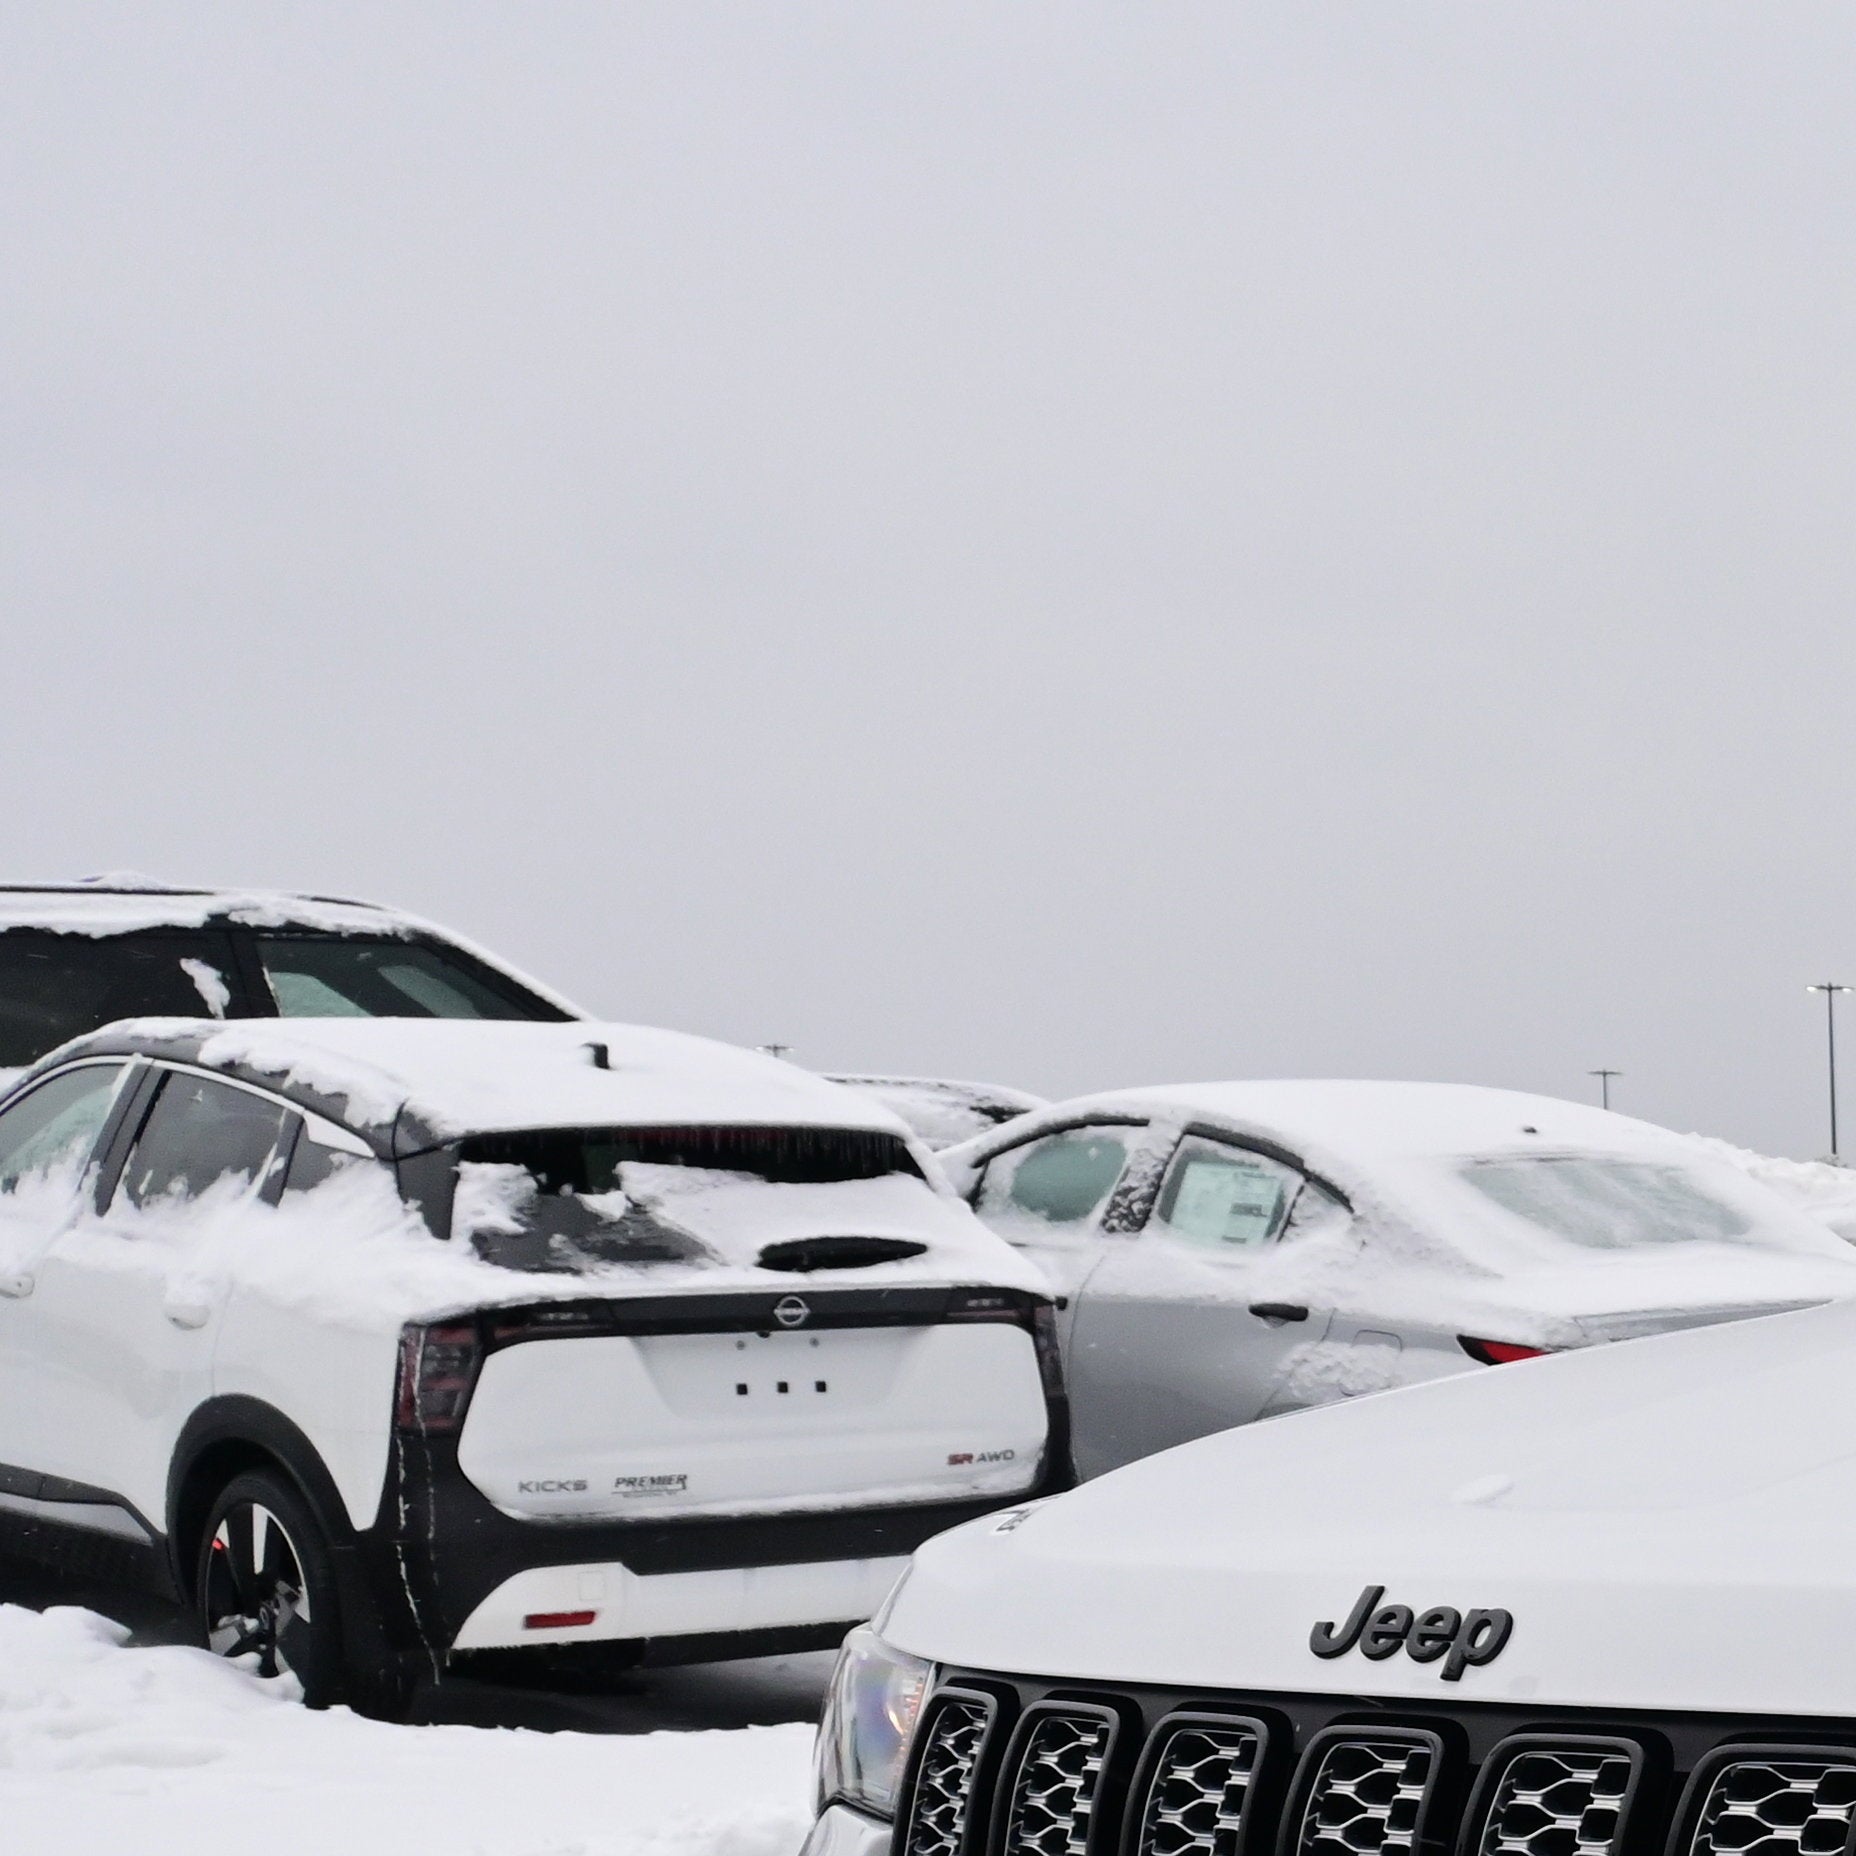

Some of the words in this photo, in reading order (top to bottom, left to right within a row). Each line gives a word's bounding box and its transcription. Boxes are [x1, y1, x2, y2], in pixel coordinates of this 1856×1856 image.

[947, 1453, 974, 1466] SR
[977, 1449, 1015, 1463] AWD
[518, 1480, 588, 1493] KICKS
[614, 1474, 688, 1491] PREMIER
[1309, 1585, 1513, 1681] Jeep
